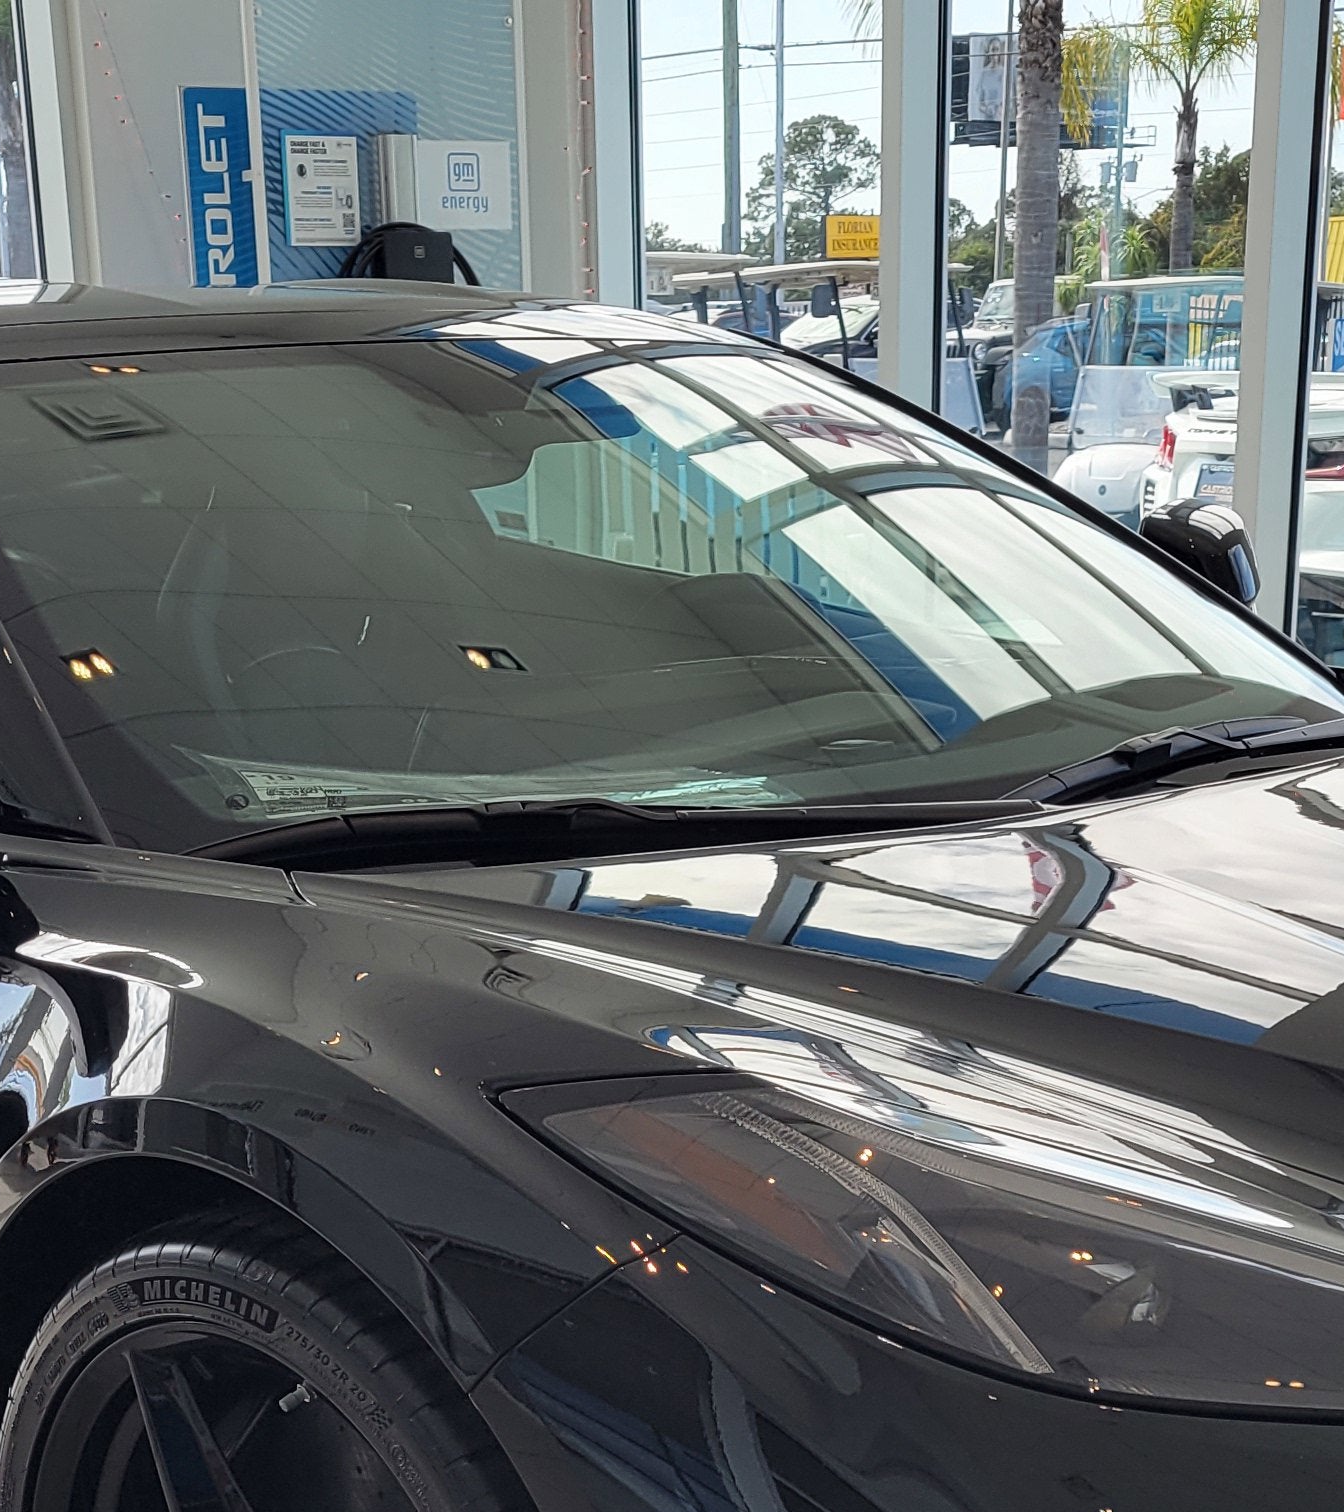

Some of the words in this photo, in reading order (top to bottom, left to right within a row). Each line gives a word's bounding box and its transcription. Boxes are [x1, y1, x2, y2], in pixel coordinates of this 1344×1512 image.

[453, 162, 475, 183] gm
[196, 103, 237, 286] ROLET
[441, 196, 489, 213] energy
[837, 221, 874, 234] FLORIAN
[143, 1279, 270, 1327] MICHELIN
[286, 1325, 331, 1367] 275/30
[330, 1362, 350, 1386] ZR
[348, 1383, 367, 1403] 20
